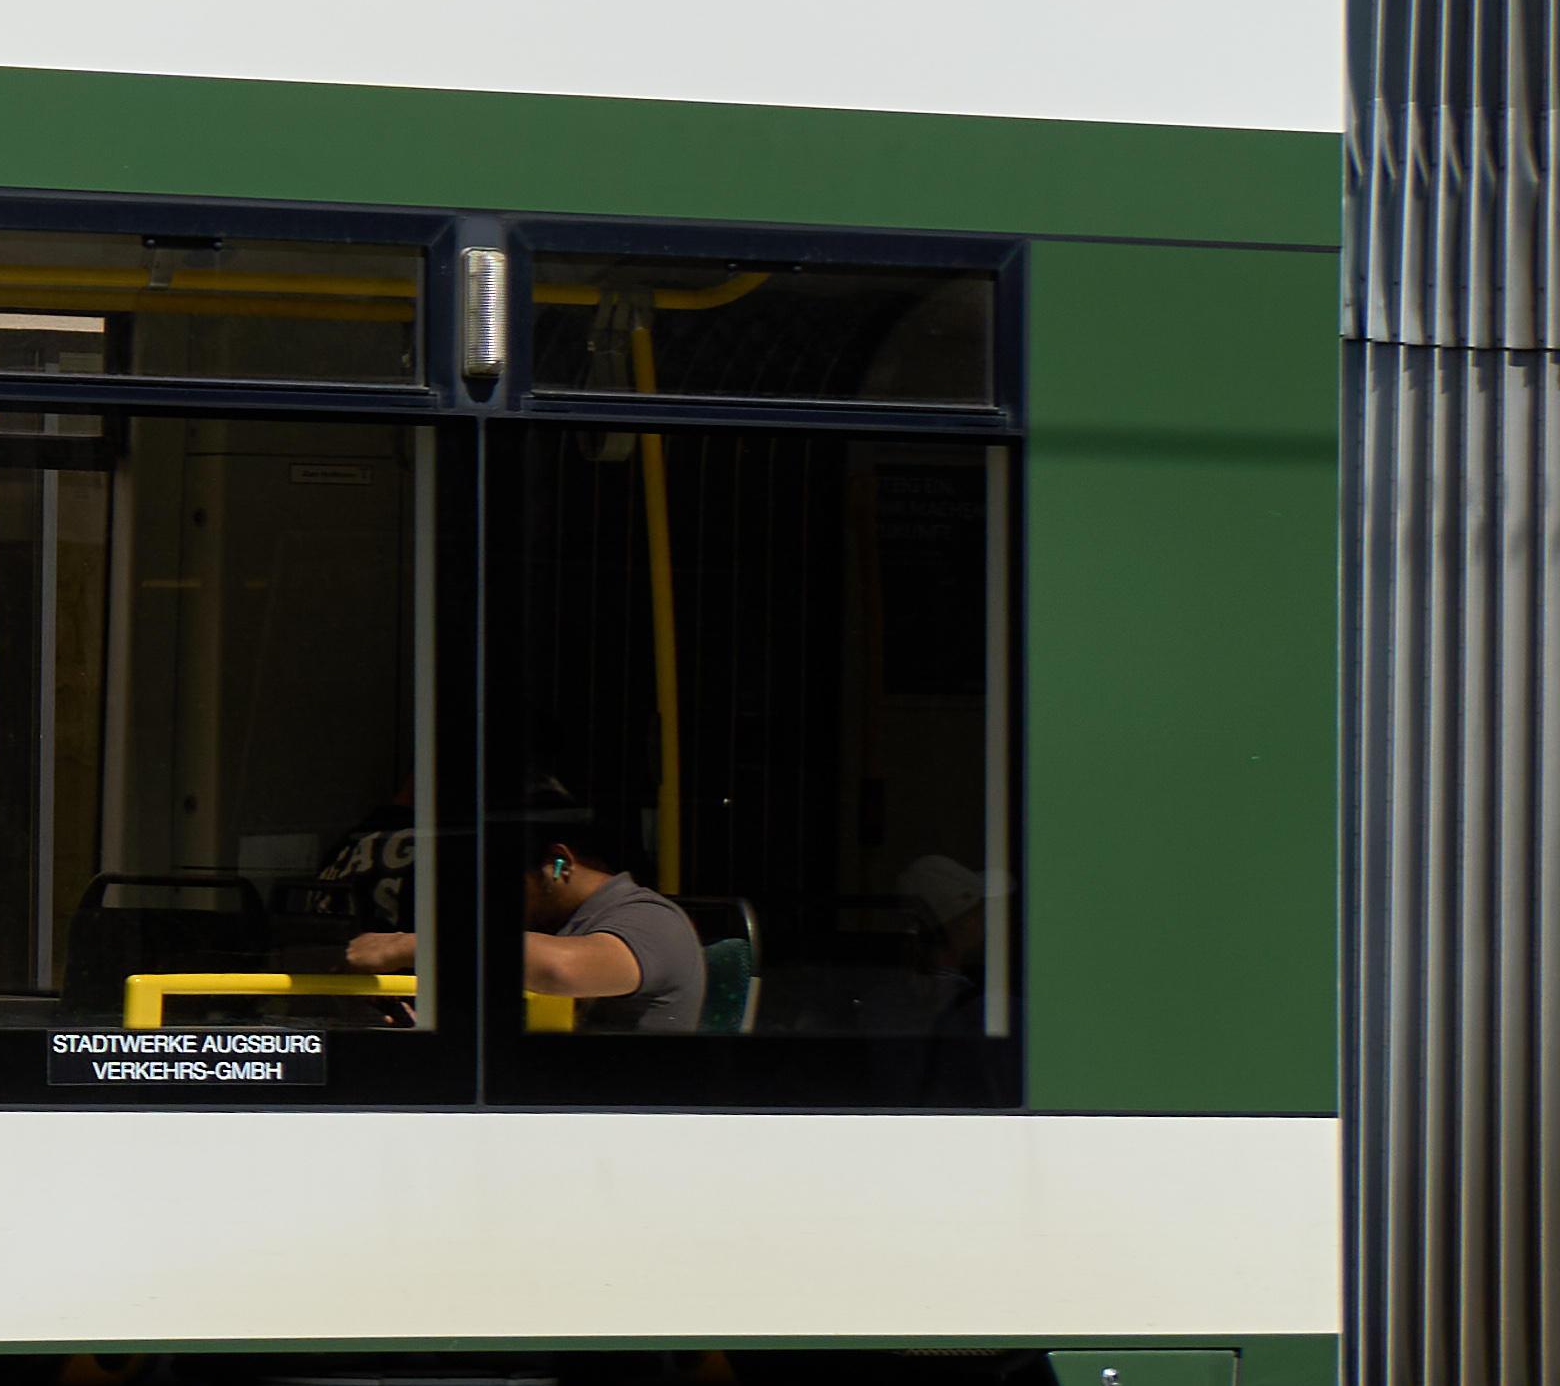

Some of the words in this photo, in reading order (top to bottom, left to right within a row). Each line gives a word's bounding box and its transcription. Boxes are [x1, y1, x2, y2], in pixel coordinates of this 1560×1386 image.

[52, 1034, 197, 1054] STADTWERKE
[201, 1034, 321, 1054] AUGSBURG
[92, 1061, 283, 1080] VERKEHRS-GMBH
